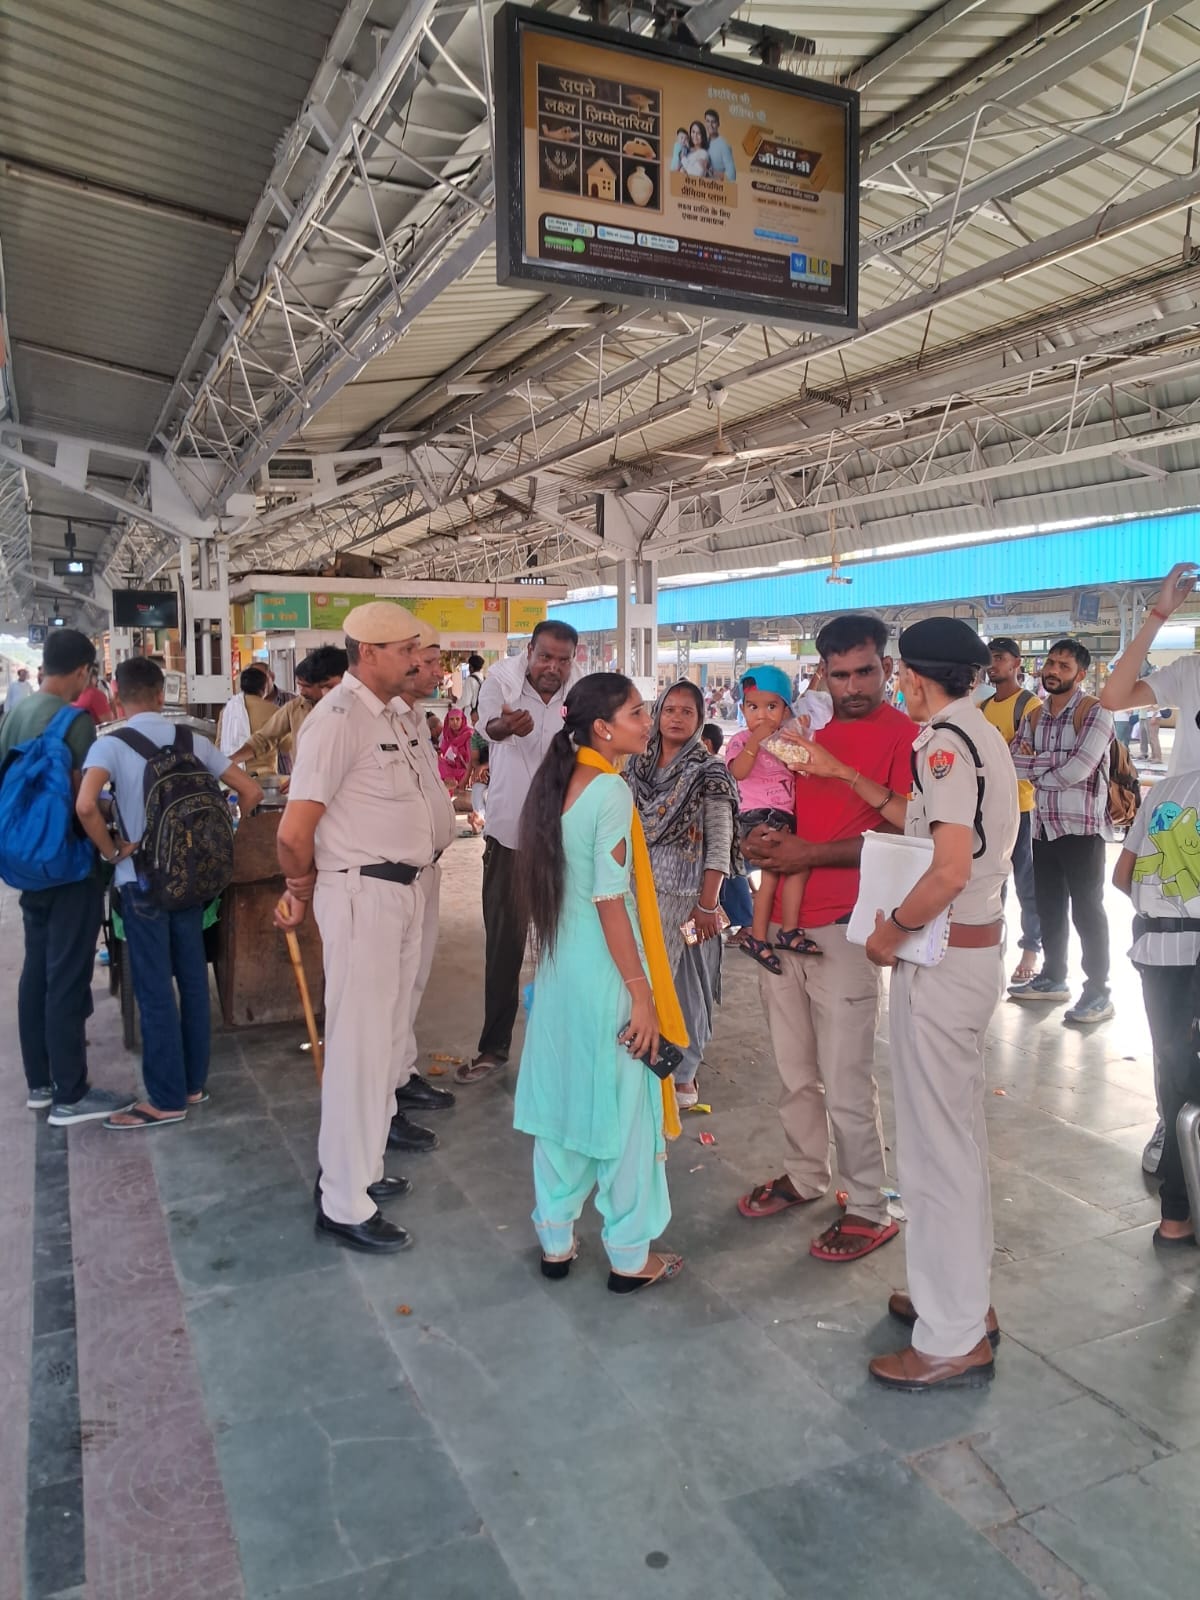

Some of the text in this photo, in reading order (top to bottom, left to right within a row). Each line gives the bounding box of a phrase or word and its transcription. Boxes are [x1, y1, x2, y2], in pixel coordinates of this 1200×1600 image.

[559, 78, 596, 98] सपने
[544, 97, 576, 116] लक्ष्य
[584, 127, 618, 146] सुरक्षा
[809, 257, 829, 276] LIC
